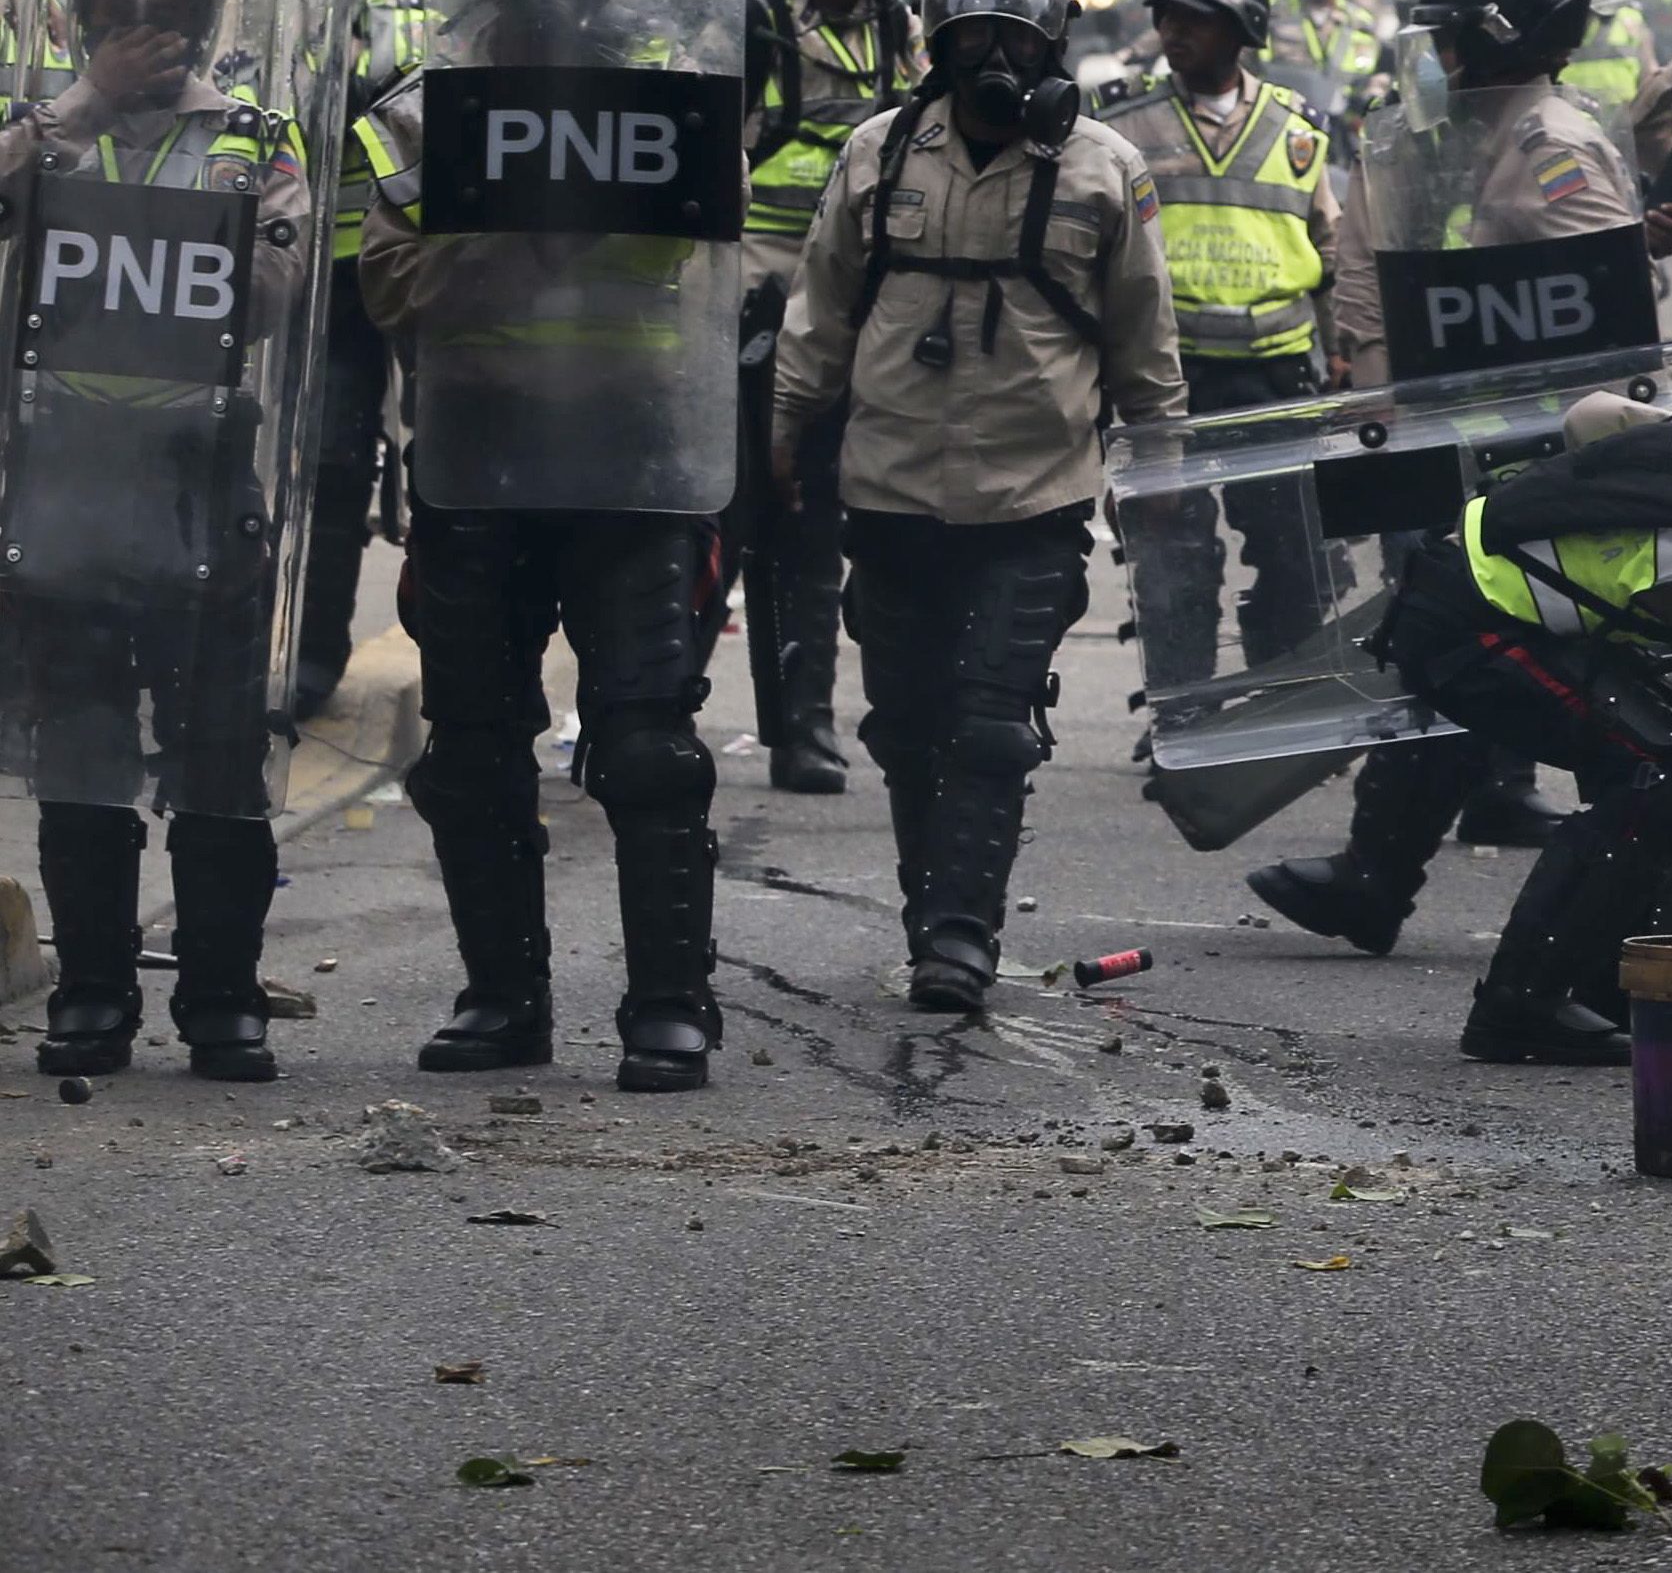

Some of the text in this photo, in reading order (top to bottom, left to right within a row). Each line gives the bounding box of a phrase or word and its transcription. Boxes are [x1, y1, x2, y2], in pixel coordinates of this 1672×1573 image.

[486, 109, 679, 184] PNB
[39, 230, 236, 320] PNB
[1427, 273, 1597, 349] PNB
